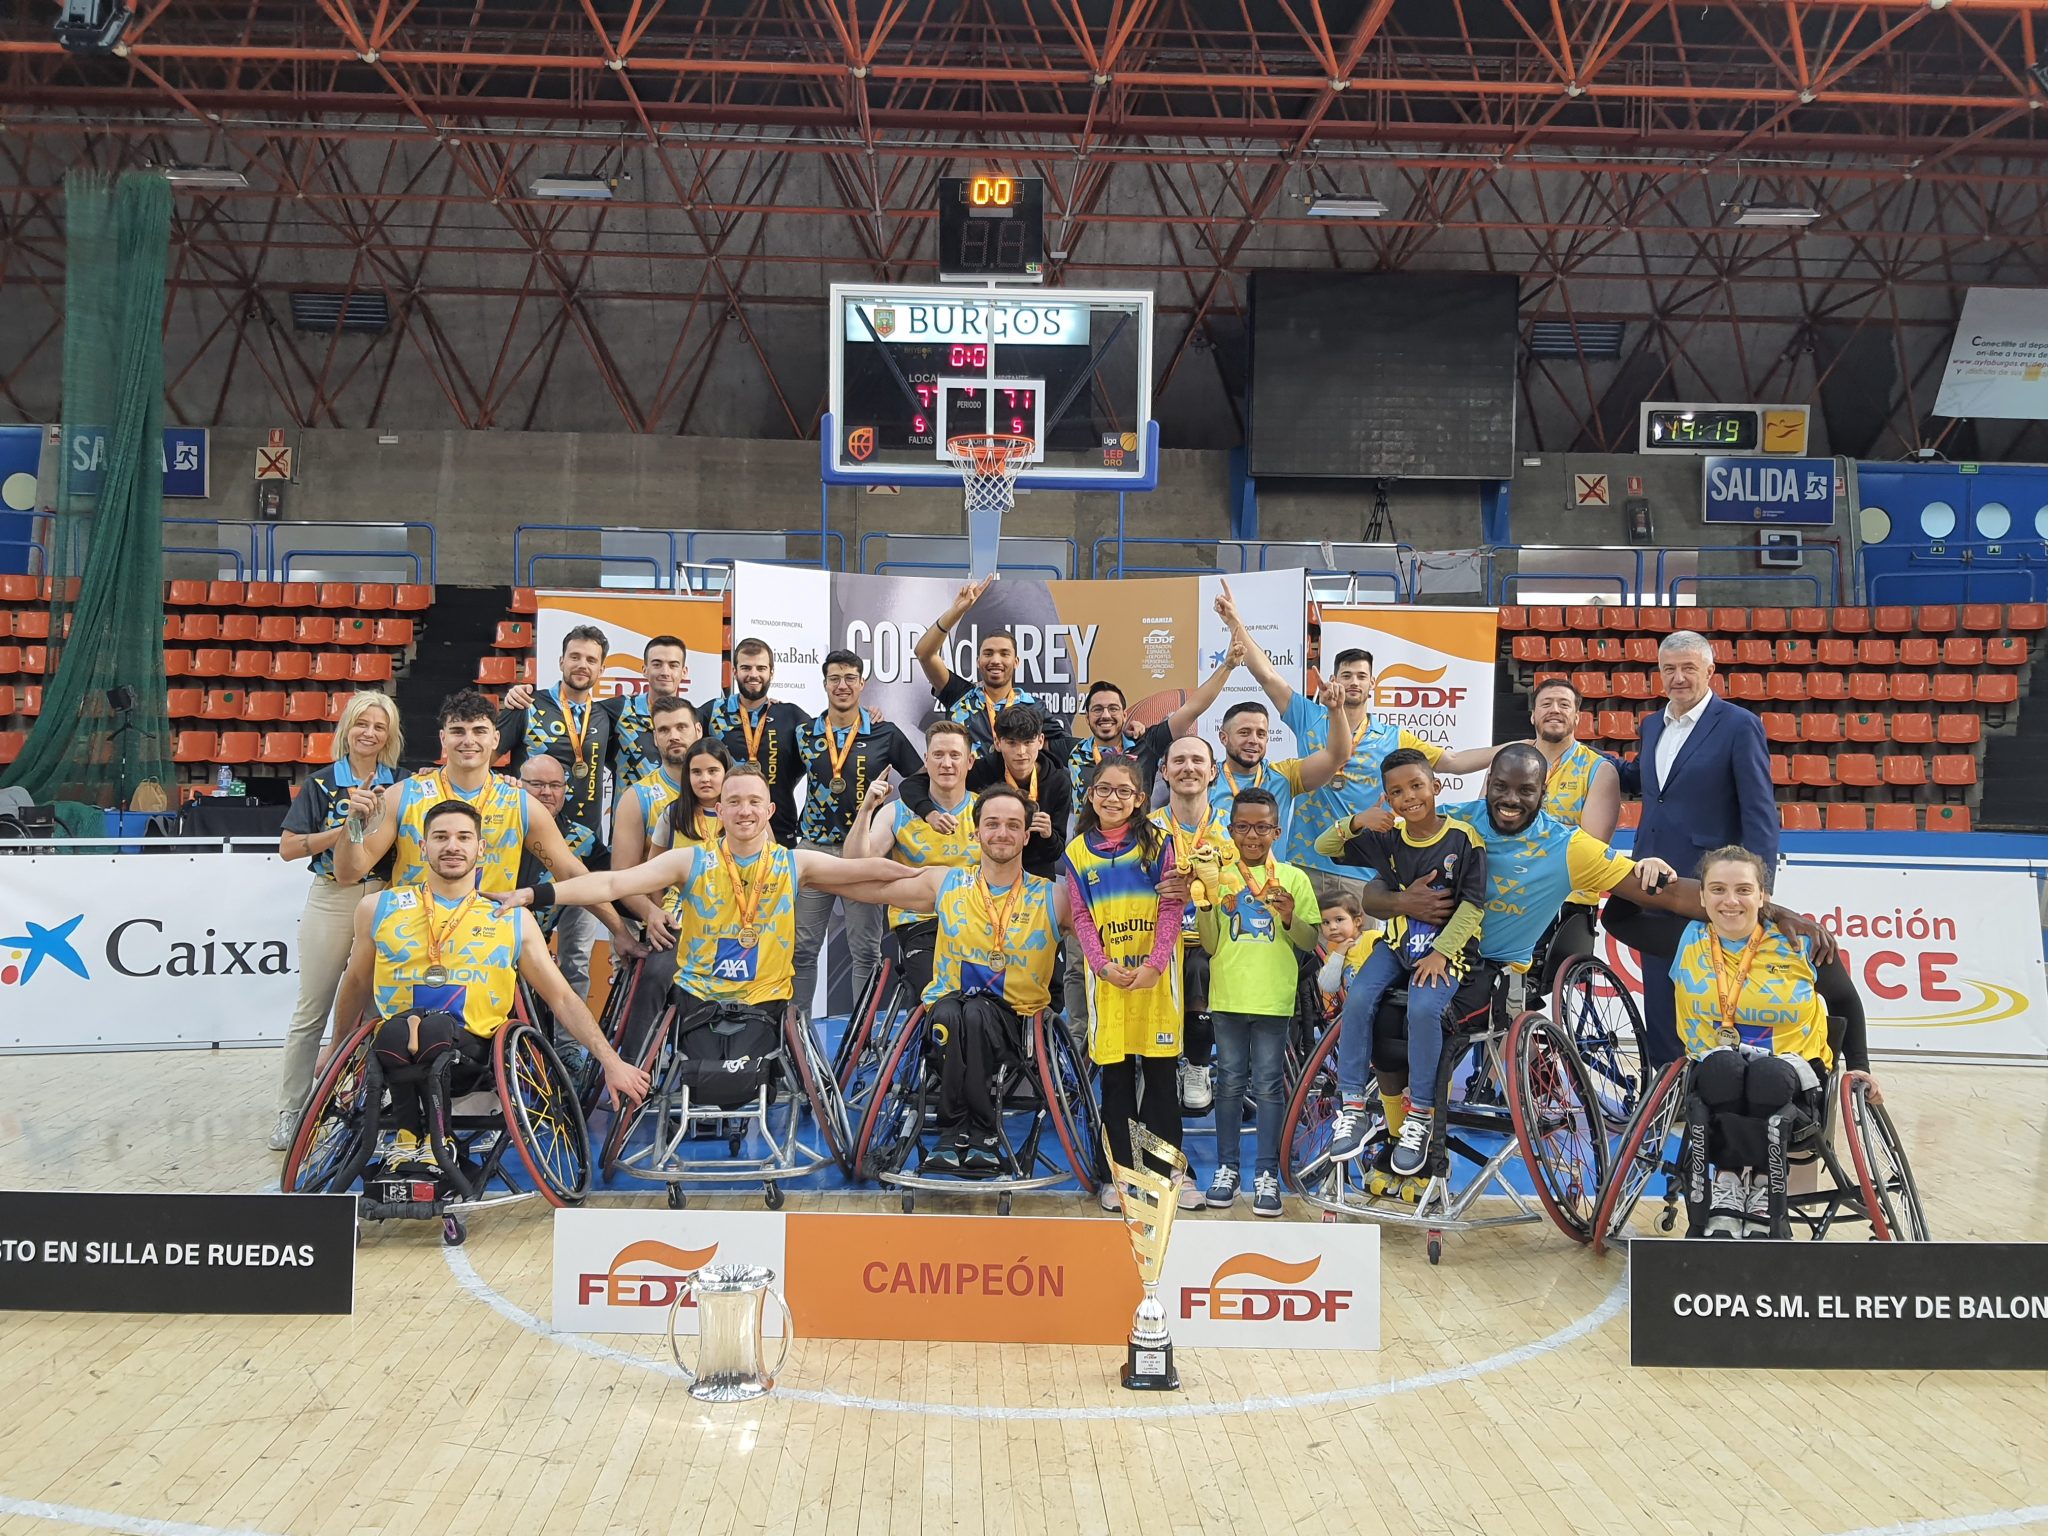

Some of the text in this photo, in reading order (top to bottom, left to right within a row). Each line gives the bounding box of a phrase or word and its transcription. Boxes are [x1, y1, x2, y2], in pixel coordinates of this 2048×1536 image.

[909, 306, 1061, 338] BURGOS
[908, 373, 939, 383] LOCA
[957, 400, 981, 409] PERIODO
[908, 436, 934, 445] FALTAS
[1103, 437, 1117, 446] Liga
[1103, 450, 1124, 459] LEB
[1103, 459, 1123, 467] ORO
[1711, 467, 1799, 502] SALIDA
[751, 618, 803, 629] PATROCINADOR PRINCIPAL
[774, 647, 819, 664] ixaBank
[846, 620, 953, 685] COP
[1062, 692, 1076, 713] de
[1369, 687, 1467, 708] EDDF
[1373, 711, 1456, 727] DERACIÓN
[767, 729, 779, 785] ILUNION
[587, 742, 600, 801] ILUNION
[943, 844, 959, 856] 23
[703, 921, 777, 936] ILUNON
[105, 918, 300, 978] Caixa
[393, 968, 488, 984] ILUION
[712, 959, 750, 978] AXA
[0, 1239, 315, 1267] TO EN SILLA DE RUEDAS
[862, 1255, 1065, 1298] CAMPEÓN
[1180, 1287, 1353, 1322] FEDDF
[1673, 1293, 2048, 1319] COPA S.M. EL REY DE BALON
